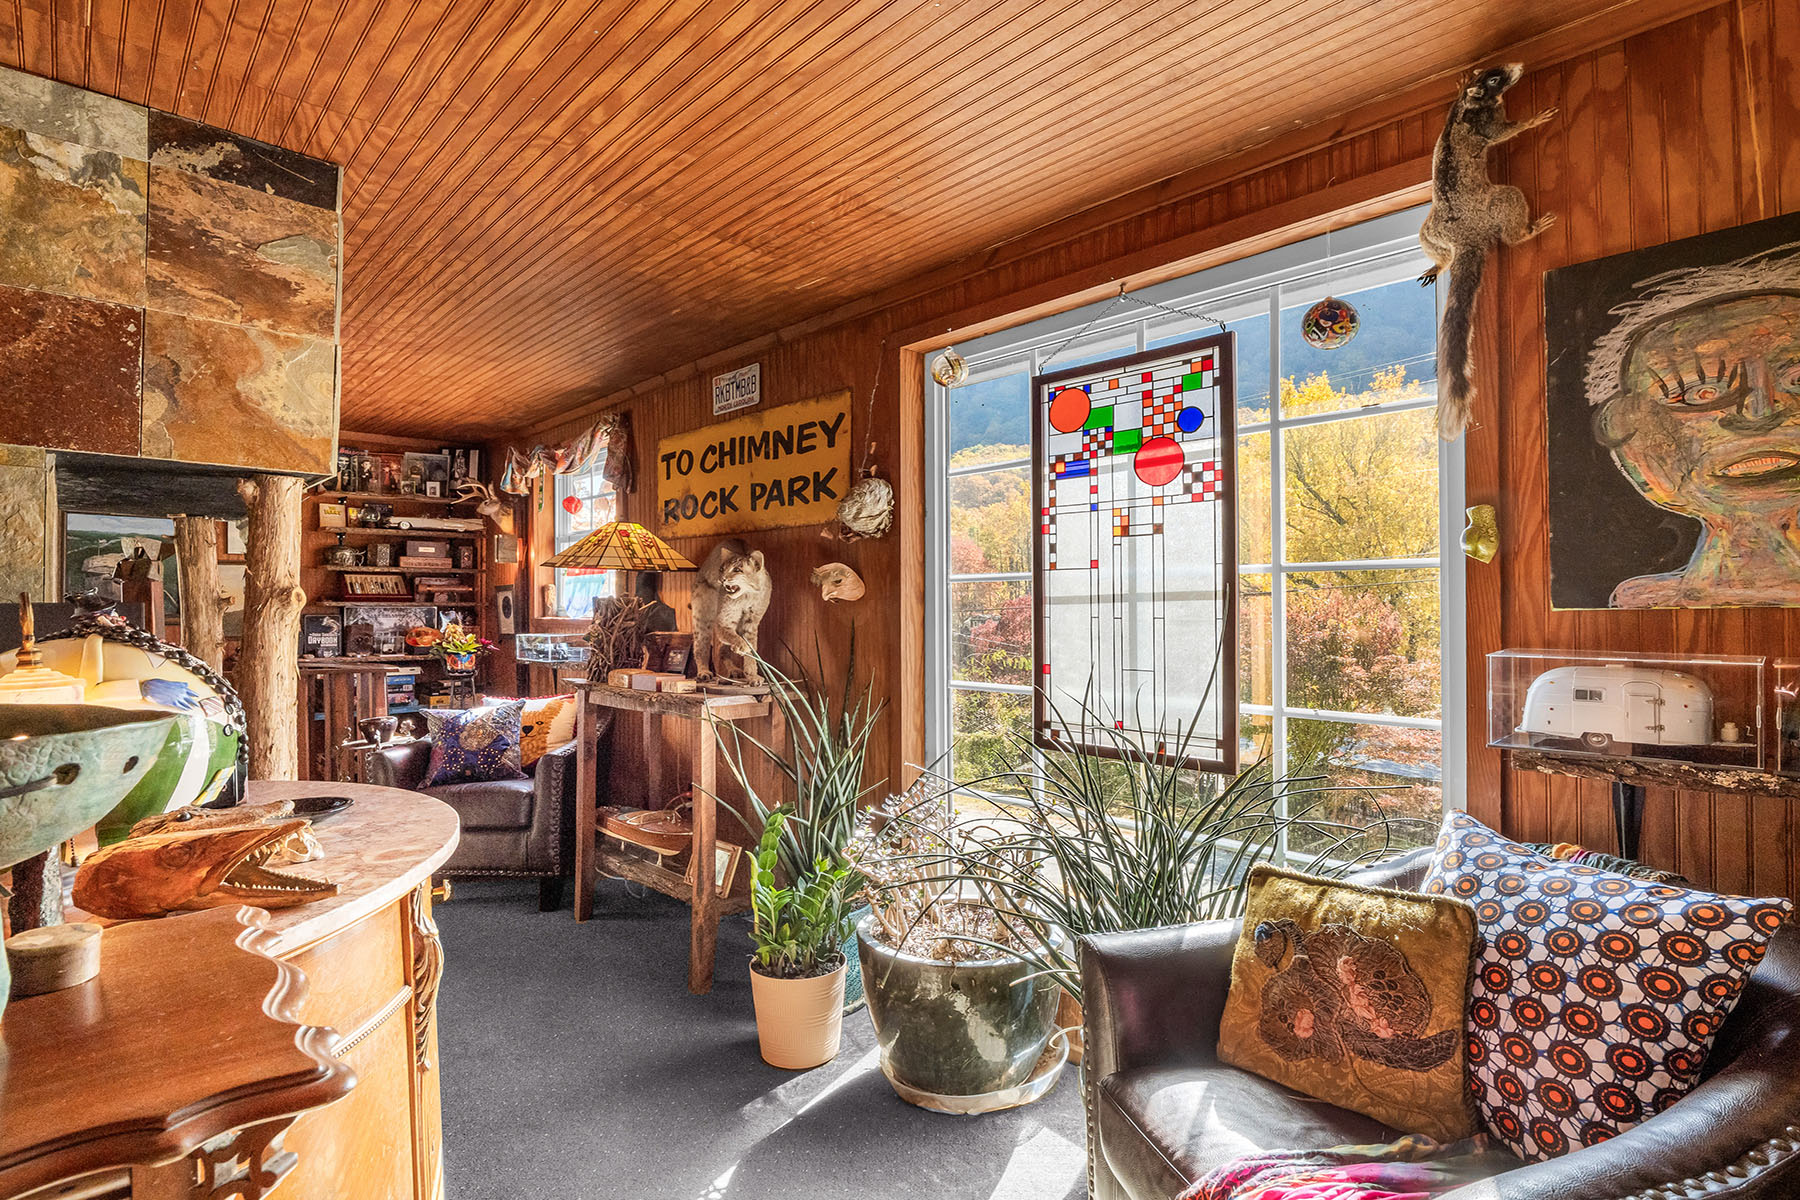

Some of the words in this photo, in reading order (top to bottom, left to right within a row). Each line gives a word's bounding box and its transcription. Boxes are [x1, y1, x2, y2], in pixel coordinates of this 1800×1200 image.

[660, 450, 694, 480] TO
[700, 412, 846, 474] CHIMNEY
[663, 485, 739, 525] ROCK
[750, 467, 838, 512] PARK
